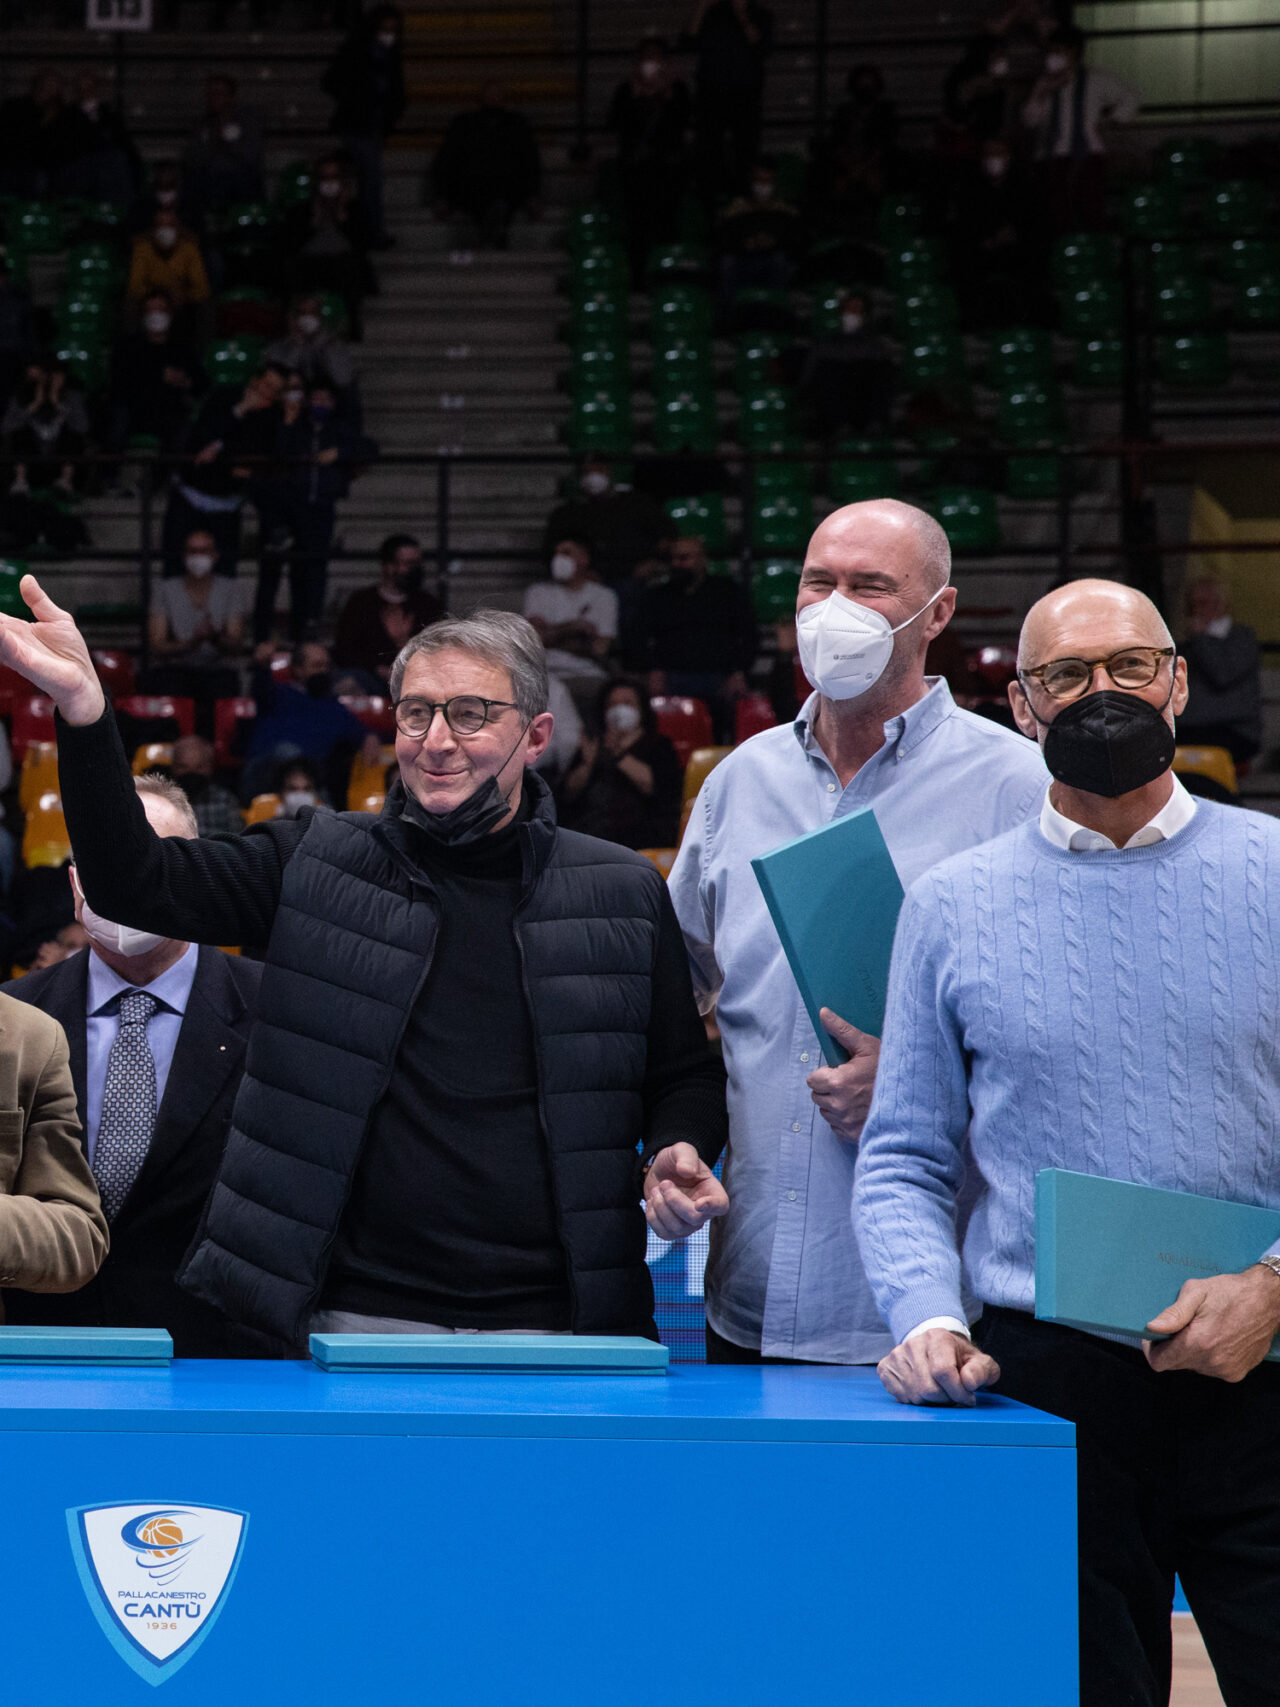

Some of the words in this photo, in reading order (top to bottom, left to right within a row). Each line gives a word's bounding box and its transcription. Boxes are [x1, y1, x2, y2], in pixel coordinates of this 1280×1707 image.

[118, 1591, 207, 1599] PALLACANESTRO
[124, 1601, 201, 1618] CANTÙ
[146, 1622, 177, 1630] 1936
